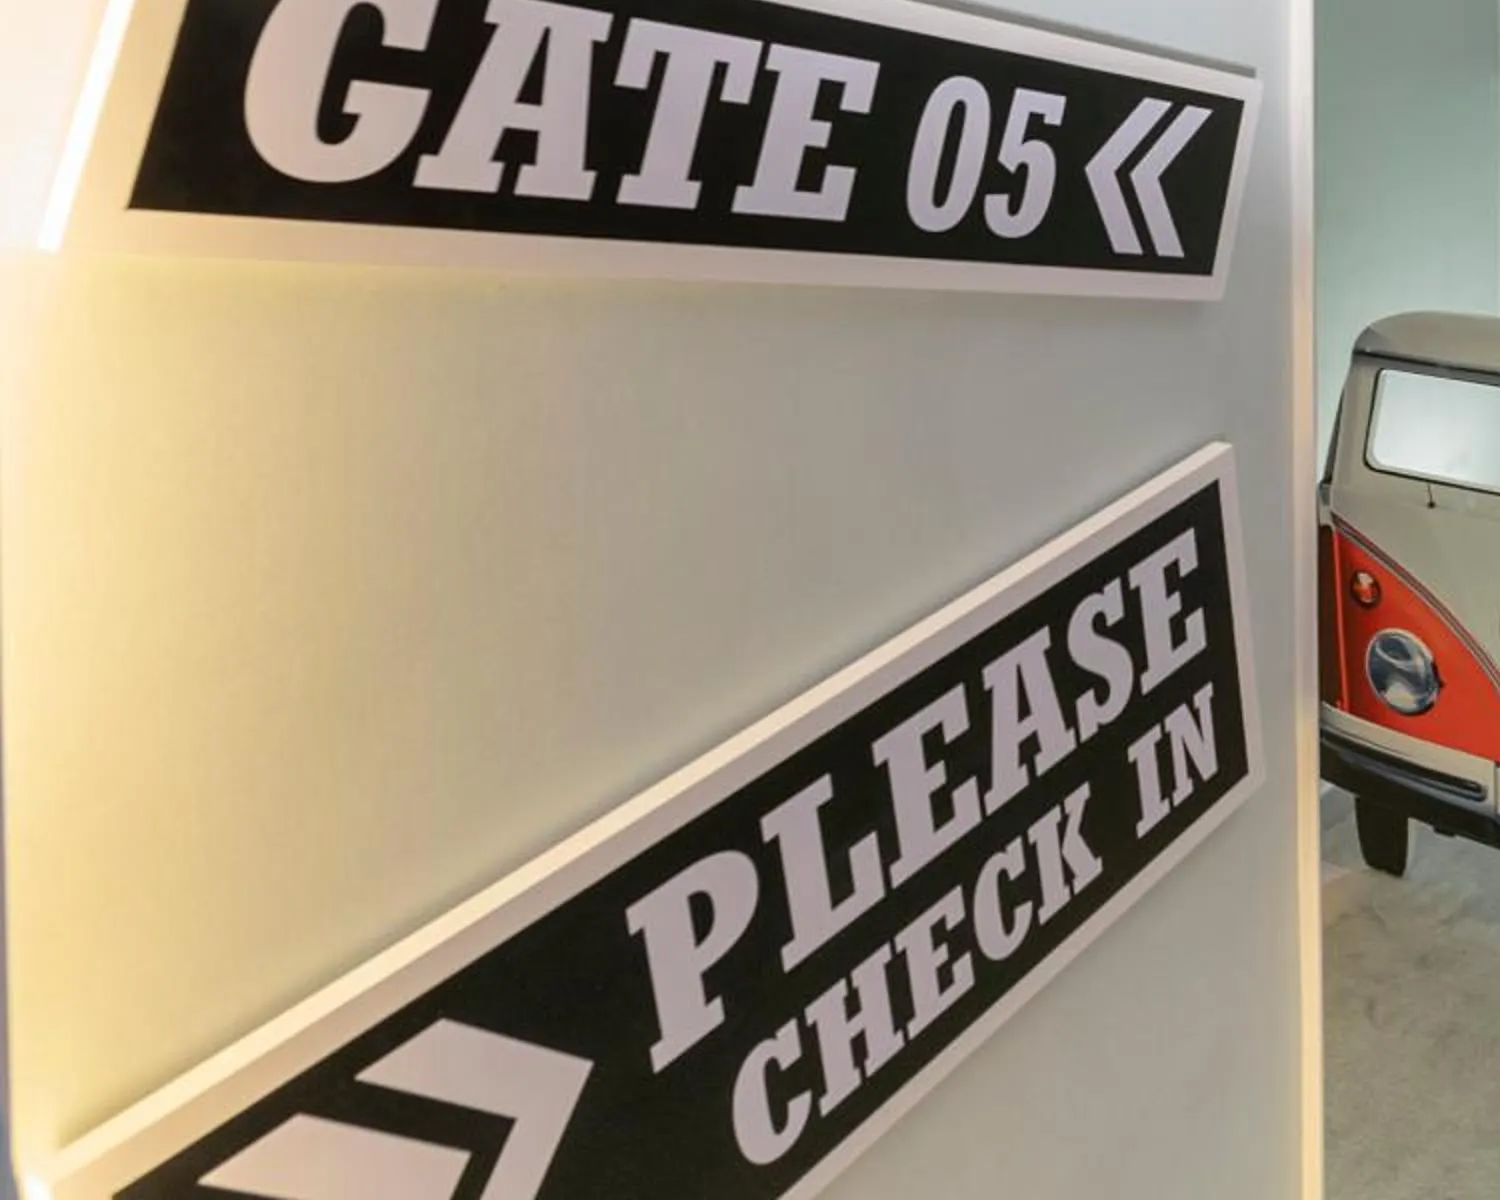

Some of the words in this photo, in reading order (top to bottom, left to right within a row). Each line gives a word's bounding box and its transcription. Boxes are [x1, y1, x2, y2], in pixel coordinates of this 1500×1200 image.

[905, 74, 1068, 238] 05
[624, 527, 1208, 1075] PLEASE
[731, 781, 1103, 1166] CHECK
[1126, 682, 1219, 840] IN
